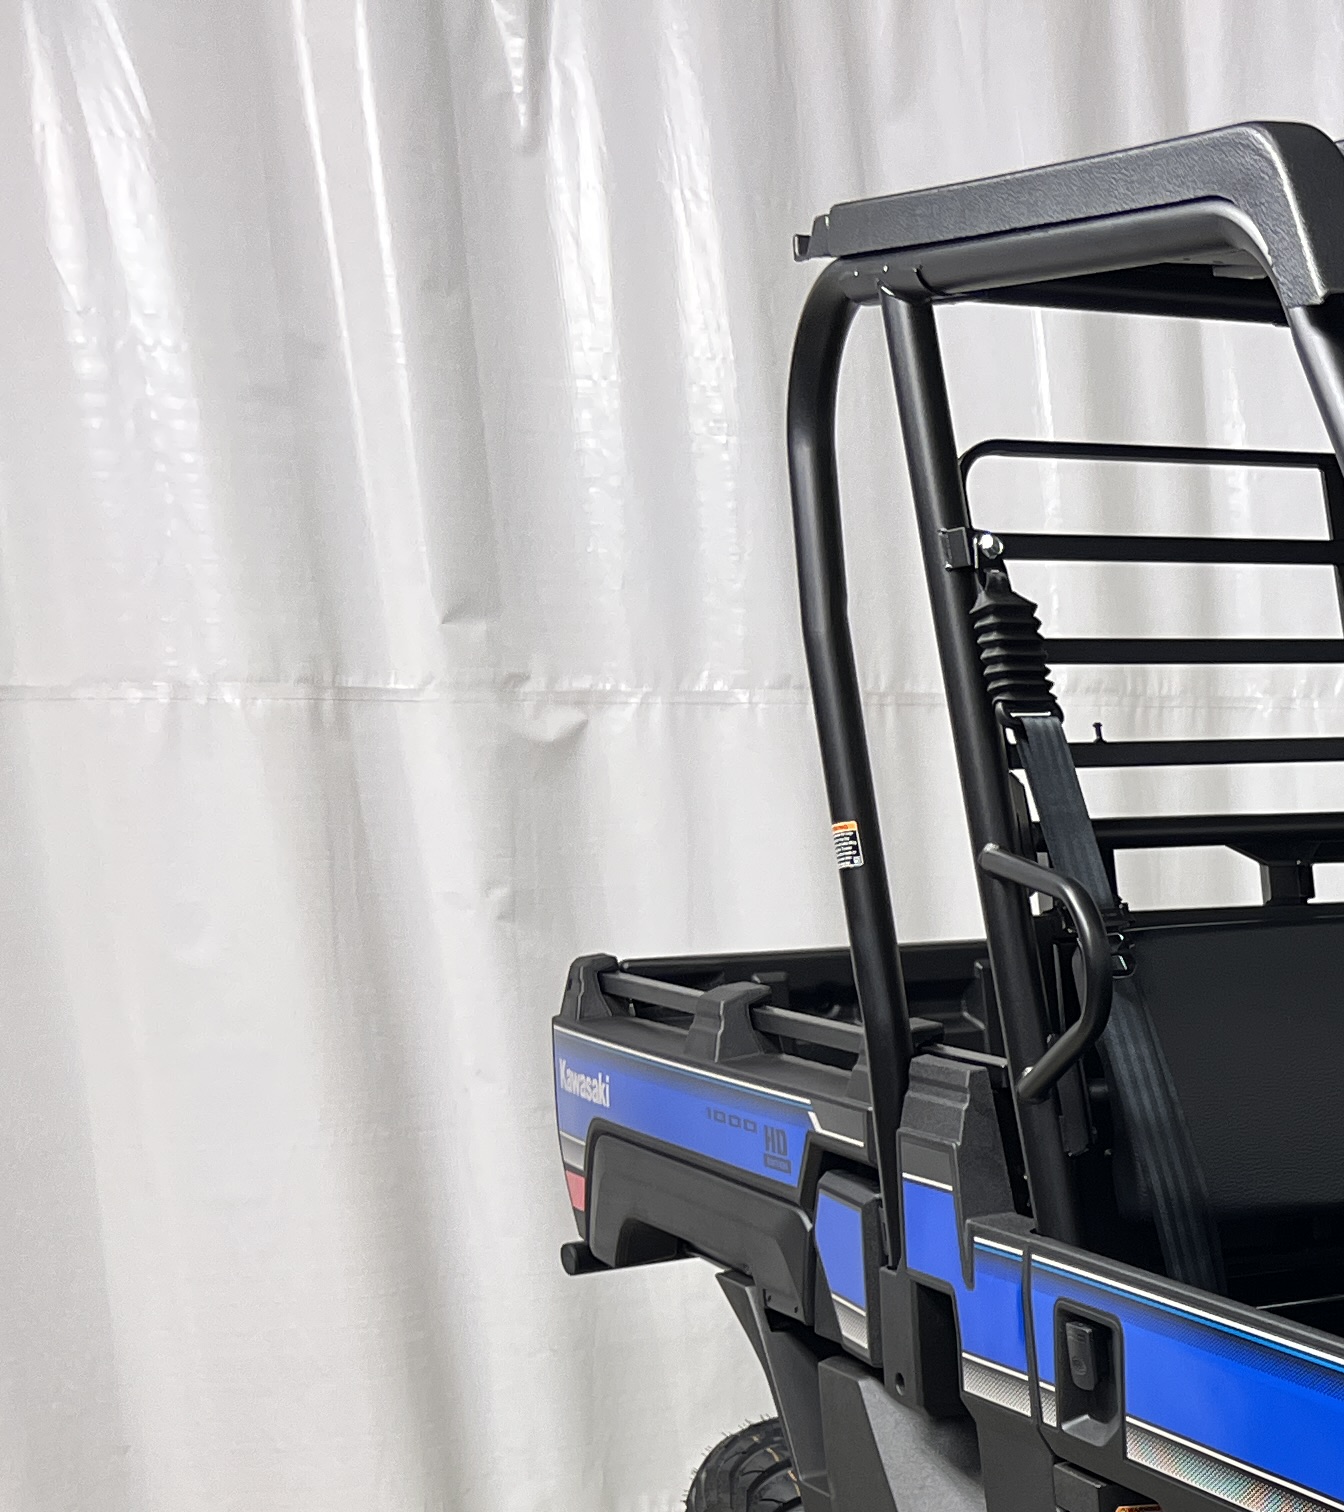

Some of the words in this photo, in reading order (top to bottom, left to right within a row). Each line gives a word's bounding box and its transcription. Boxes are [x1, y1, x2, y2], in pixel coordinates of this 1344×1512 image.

[558, 1058, 611, 1108] Kawasaki
[706, 1106, 758, 1134] 1000
[763, 1125, 788, 1157] HD
